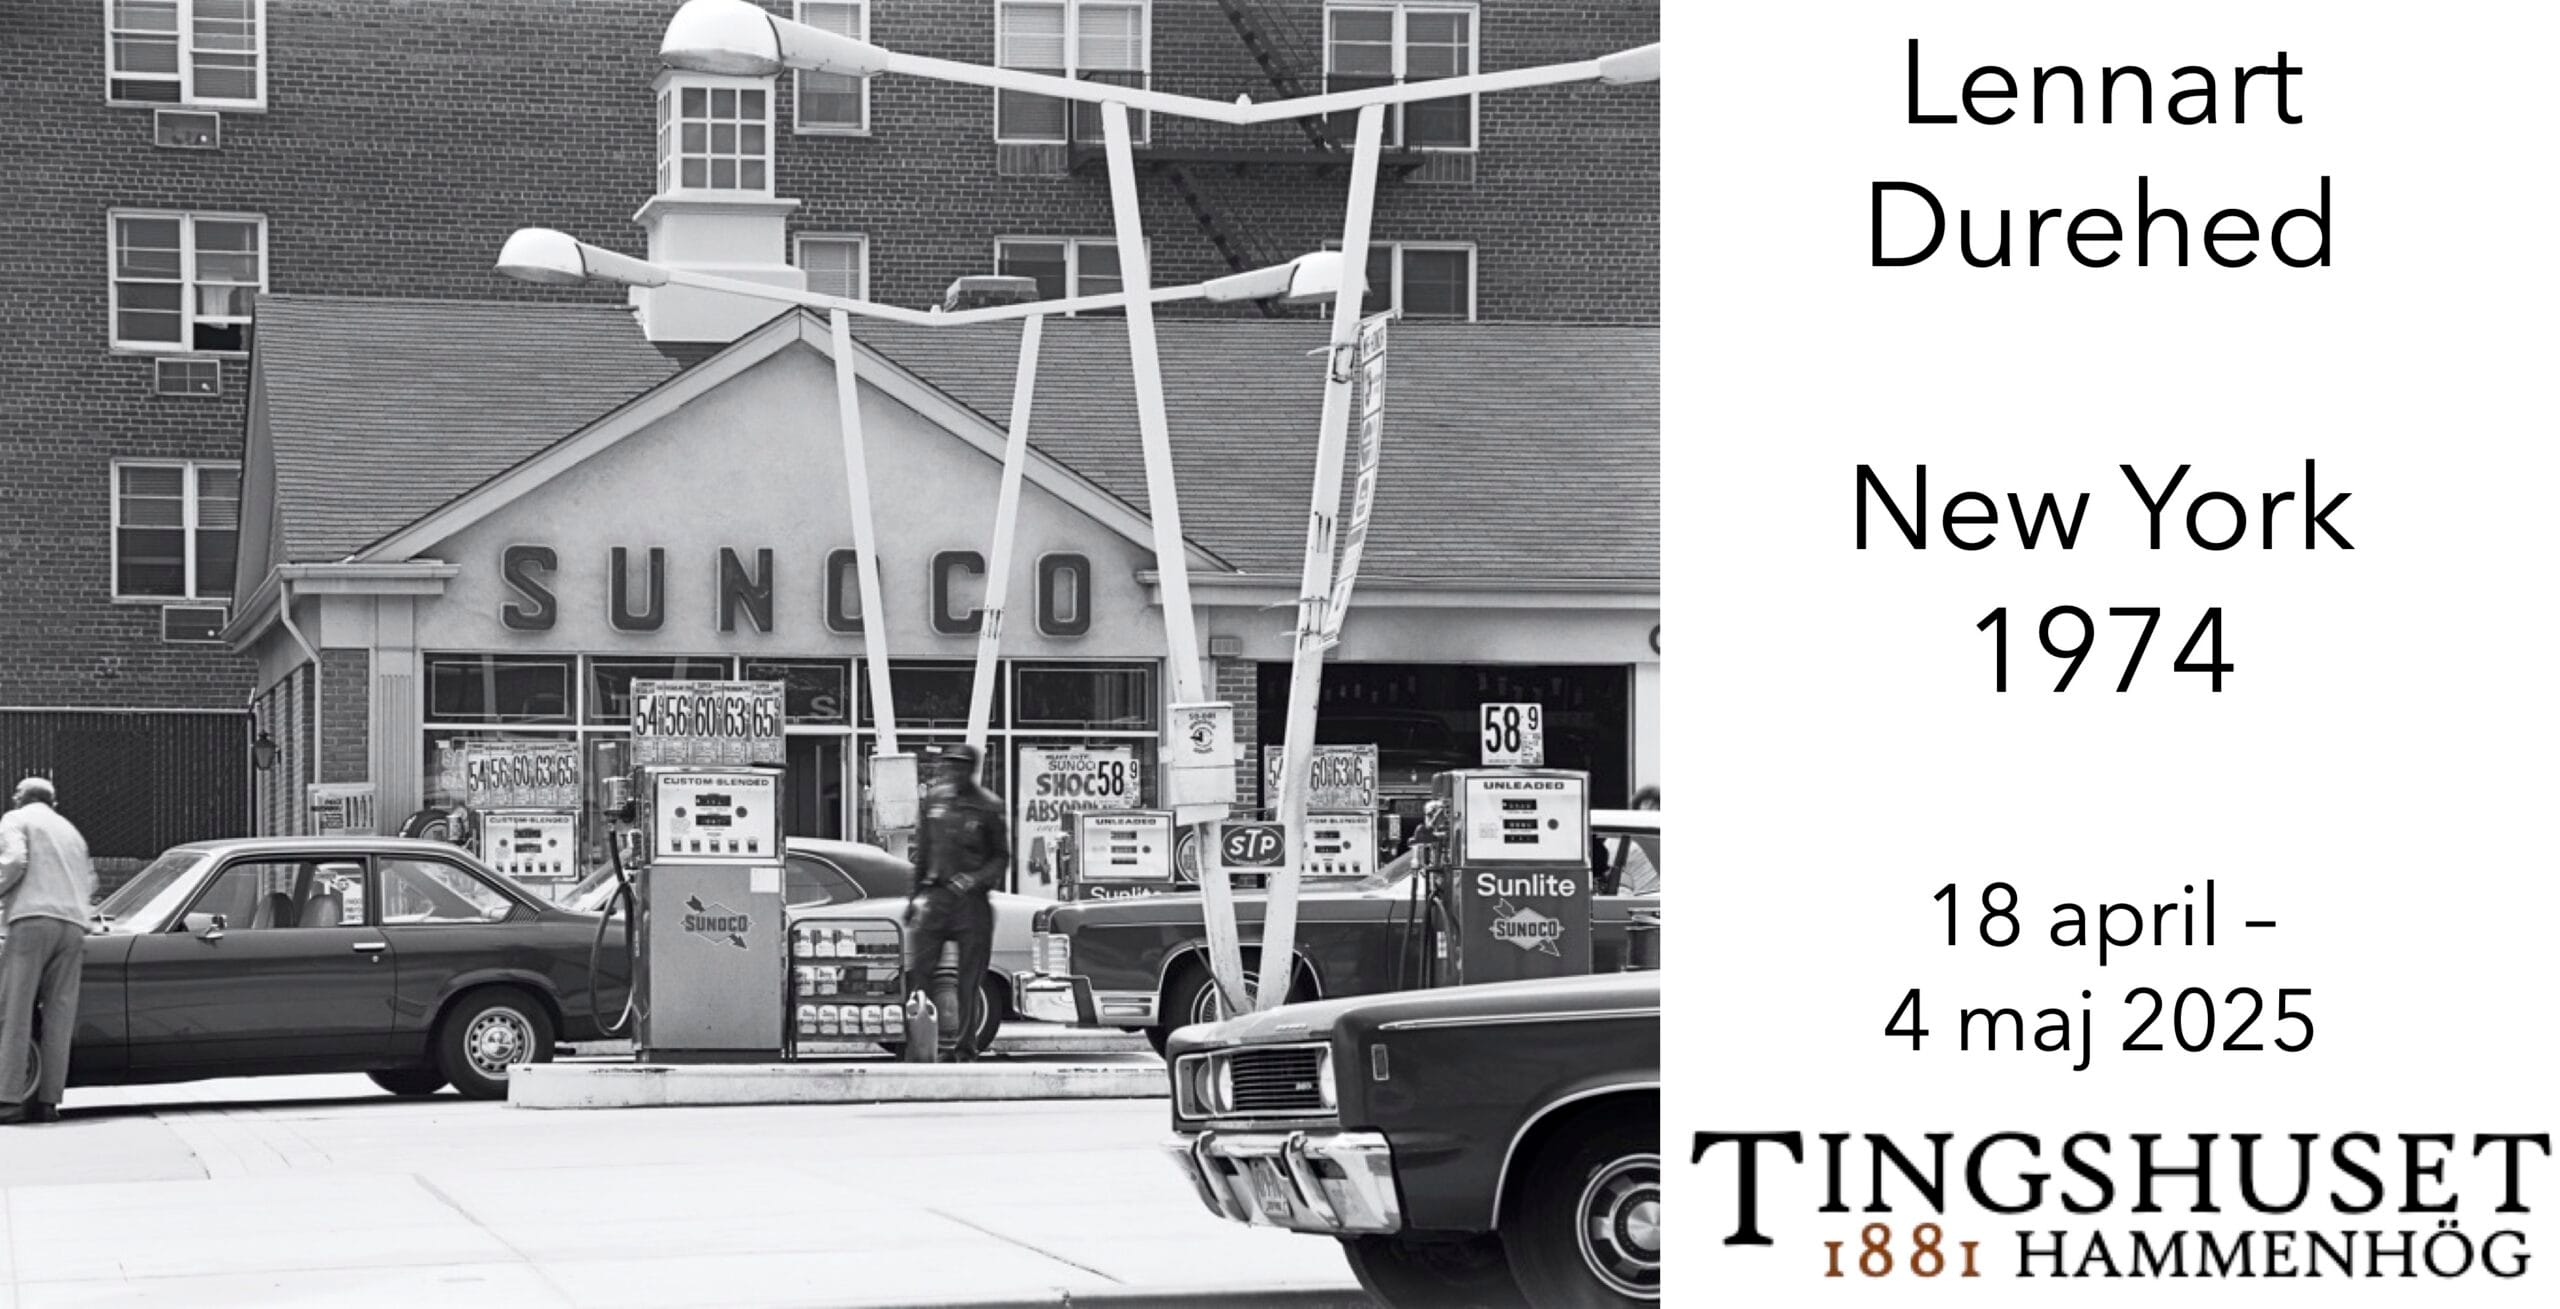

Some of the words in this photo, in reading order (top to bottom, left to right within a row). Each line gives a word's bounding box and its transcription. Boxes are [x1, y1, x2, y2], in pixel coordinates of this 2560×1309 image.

[500, 544, 1092, 638] SUNOCO
[1485, 706, 1521, 753] 58
[1048, 760, 1096, 771] SUNOC
[663, 777, 713, 785] CUSTOM
[716, 778, 770, 786] BLENDED
[1098, 761, 1125, 796] 58
[1483, 781, 1565, 790] UNLEADED
[1095, 818, 1157, 826] UNLEADED
[1229, 828, 1276, 858] STP
[1477, 872, 1577, 897] Sunlite
[685, 914, 748, 932] SUNOCO
[1496, 920, 1558, 937] SUNOCO
